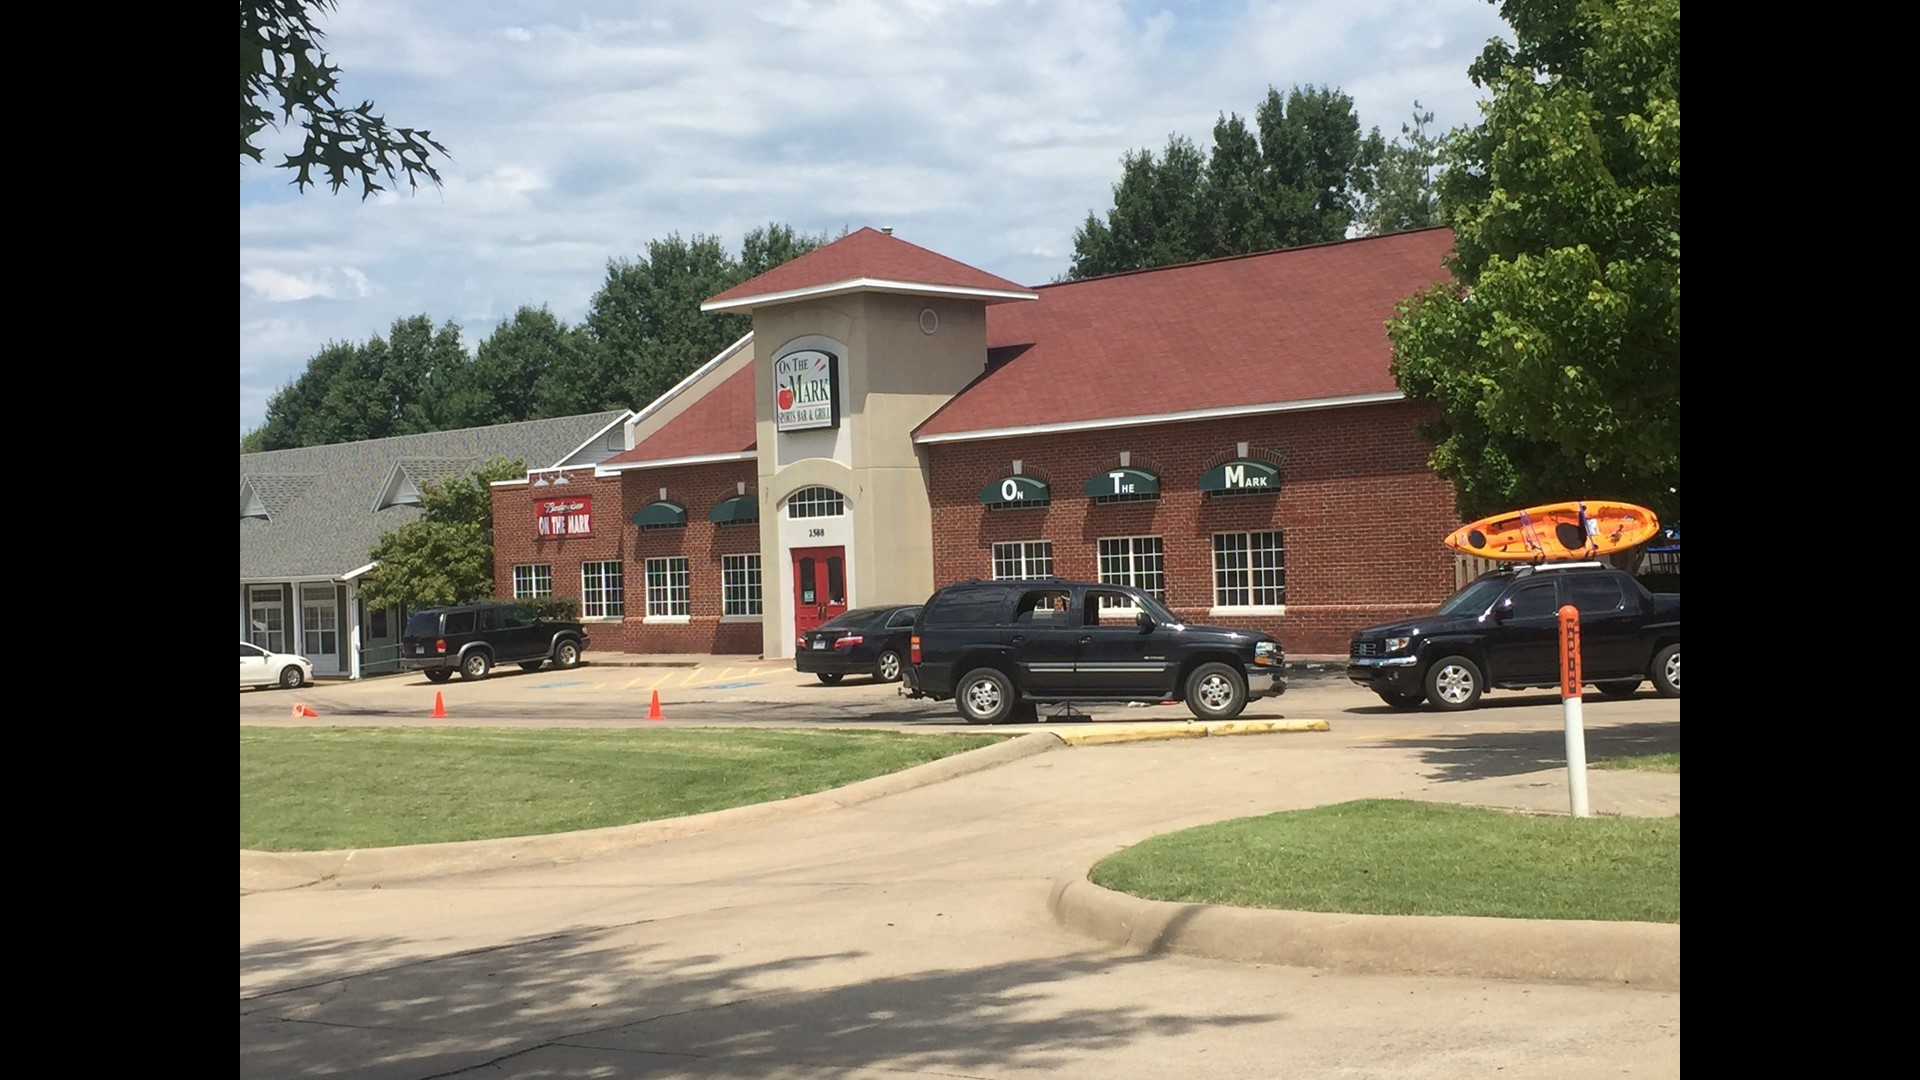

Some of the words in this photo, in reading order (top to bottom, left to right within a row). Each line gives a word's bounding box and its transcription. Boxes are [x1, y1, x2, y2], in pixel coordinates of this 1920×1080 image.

[779, 360, 791, 374] ON
[792, 358, 808, 372] THE
[789, 374, 829, 403] MARK
[1109, 472, 1134, 494] THE
[1224, 465, 1267, 488] MARK
[1001, 479, 1023, 500] ON
[538, 516, 550, 535] ON
[551, 515, 566, 534] THE
[568, 514, 590, 533] MARK
